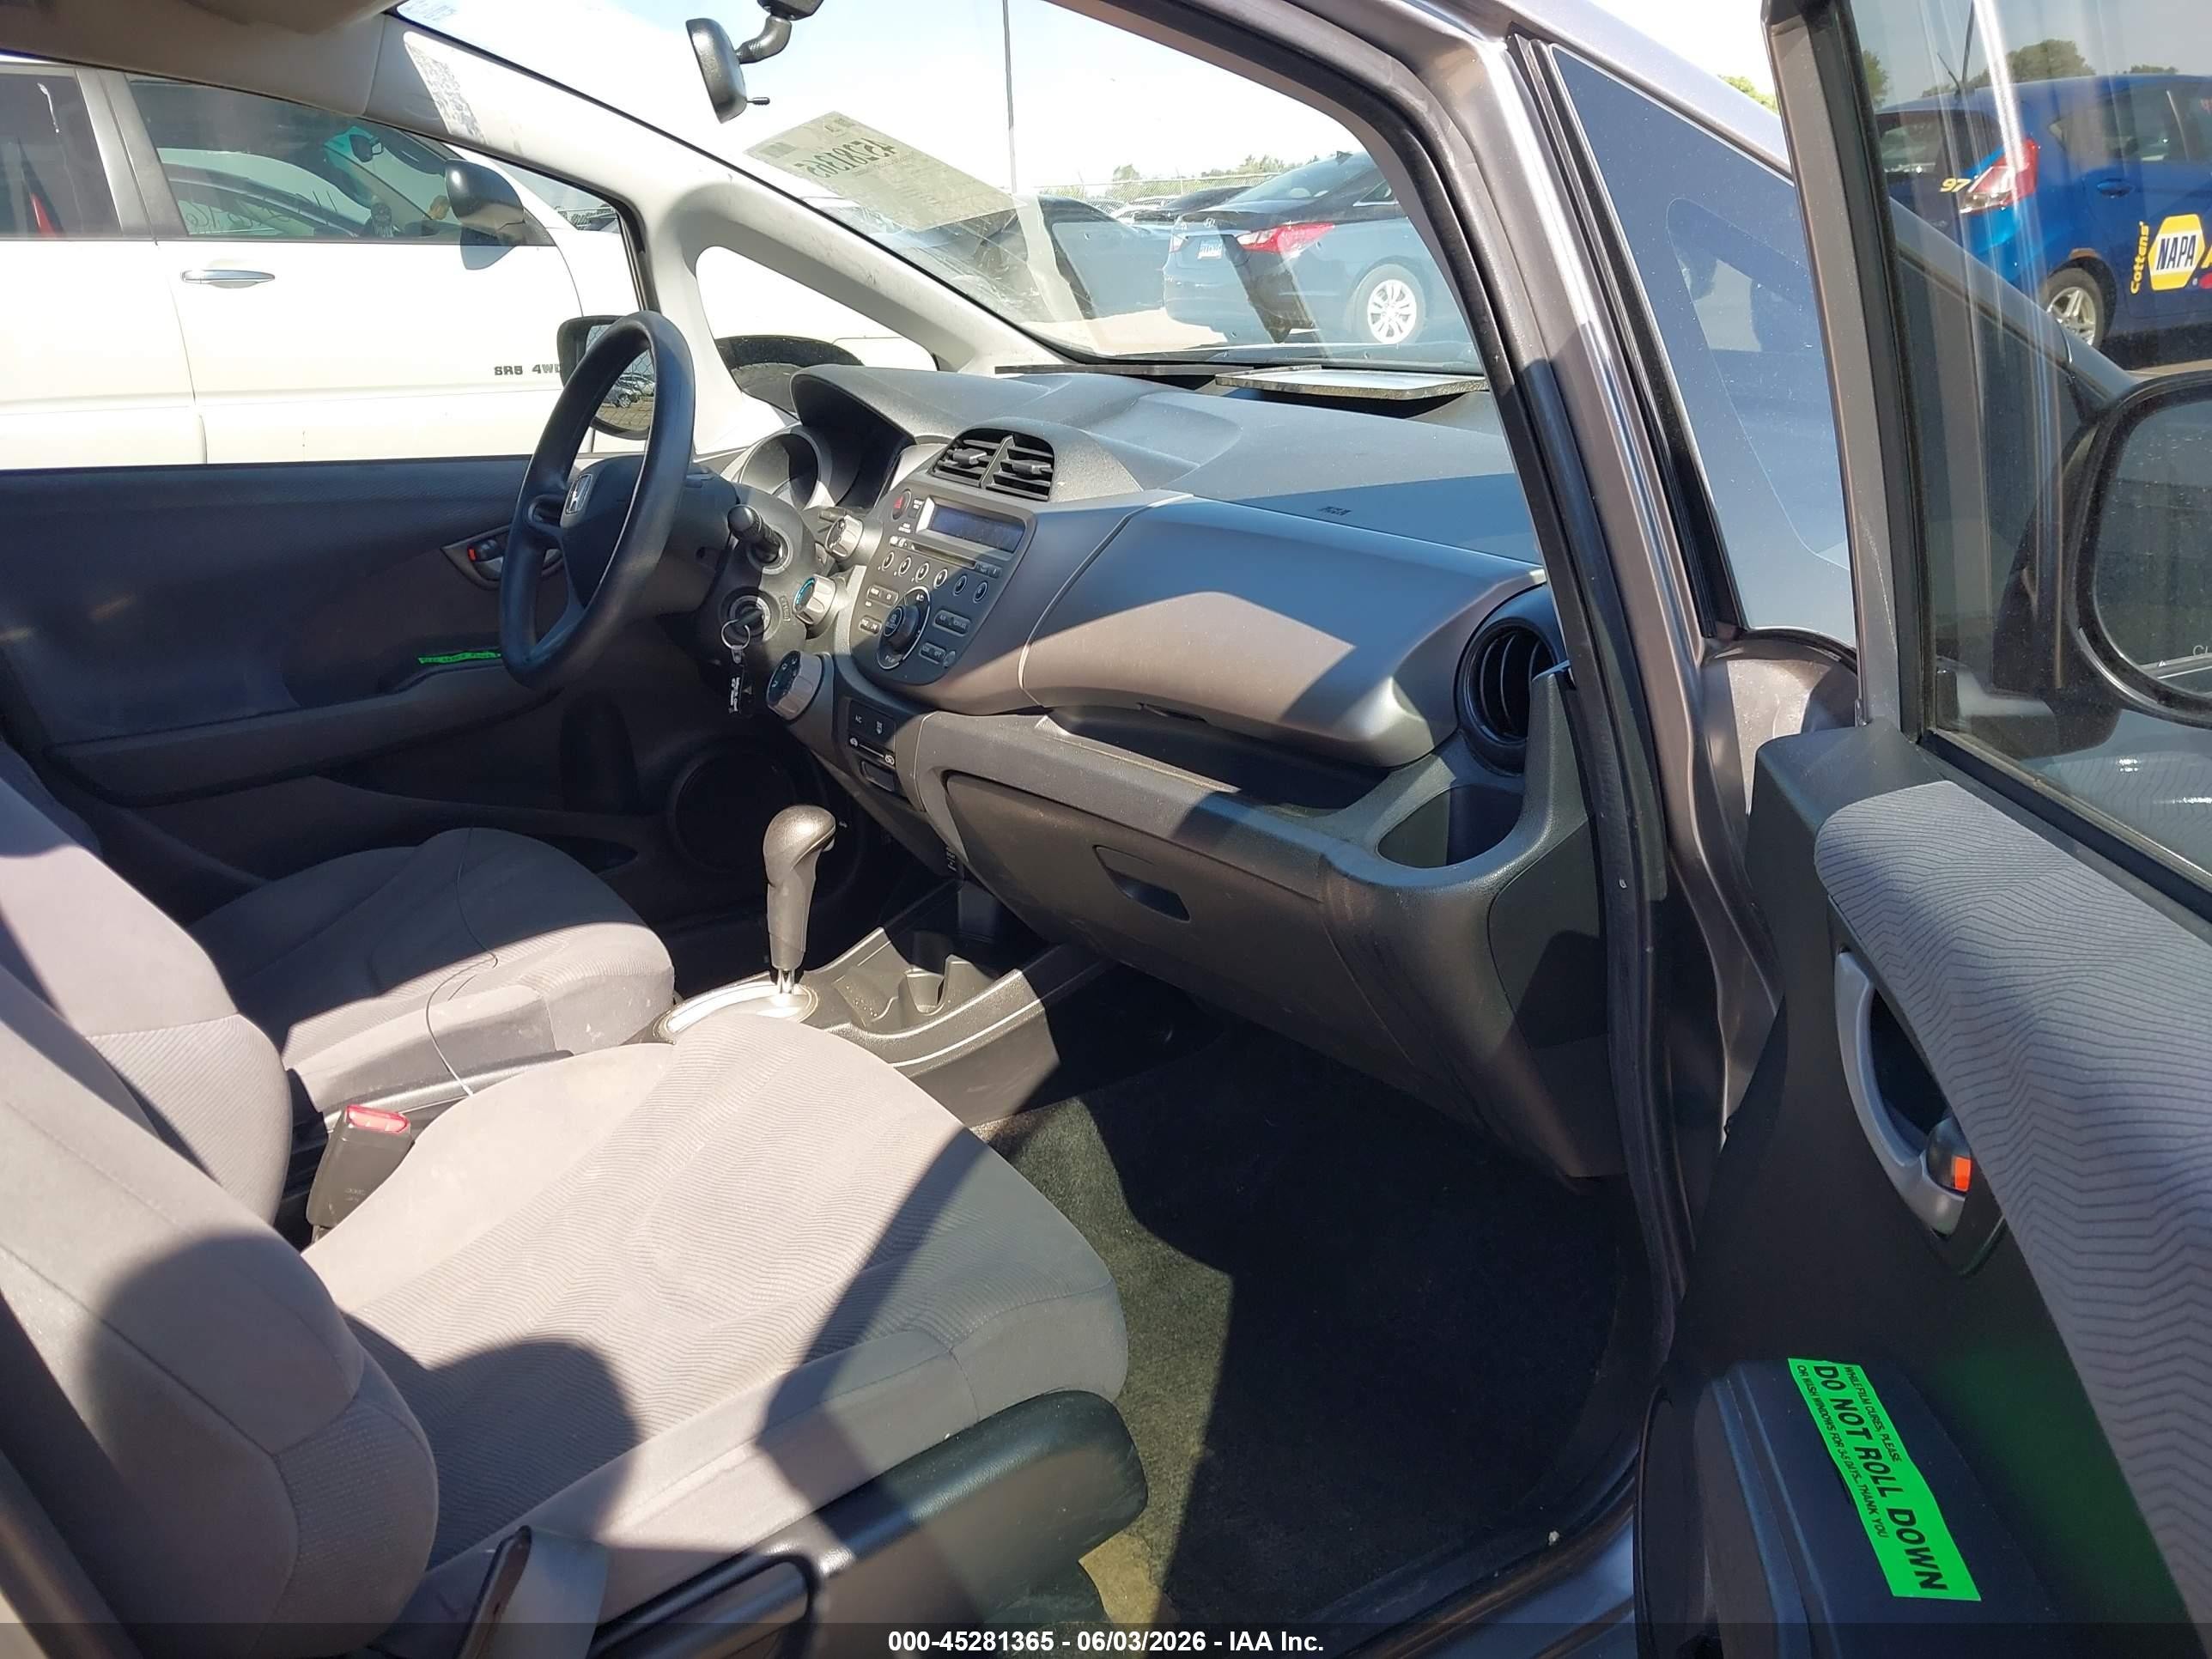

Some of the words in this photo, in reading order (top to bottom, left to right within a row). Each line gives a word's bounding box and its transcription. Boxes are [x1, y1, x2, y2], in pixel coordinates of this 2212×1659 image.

[1940, 178, 1971, 192] 97
[2156, 234, 2197, 271] NAPA
[1813, 1365, 1847, 1391] DO
[1829, 1398, 1874, 1440] NOT
[1797, 1365, 1809, 1377] OR
[1812, 1398, 1837, 1431] WINDOWS
[1830, 1431, 1845, 1448] FOR
[1857, 1484, 1880, 1515] THANK
[1872, 1518, 1889, 1538] YOU
[1880, 1432, 1903, 1462] PLEASE
[1854, 1447, 1904, 1498] ROLL
[1886, 1508, 1948, 1590] DOWN
